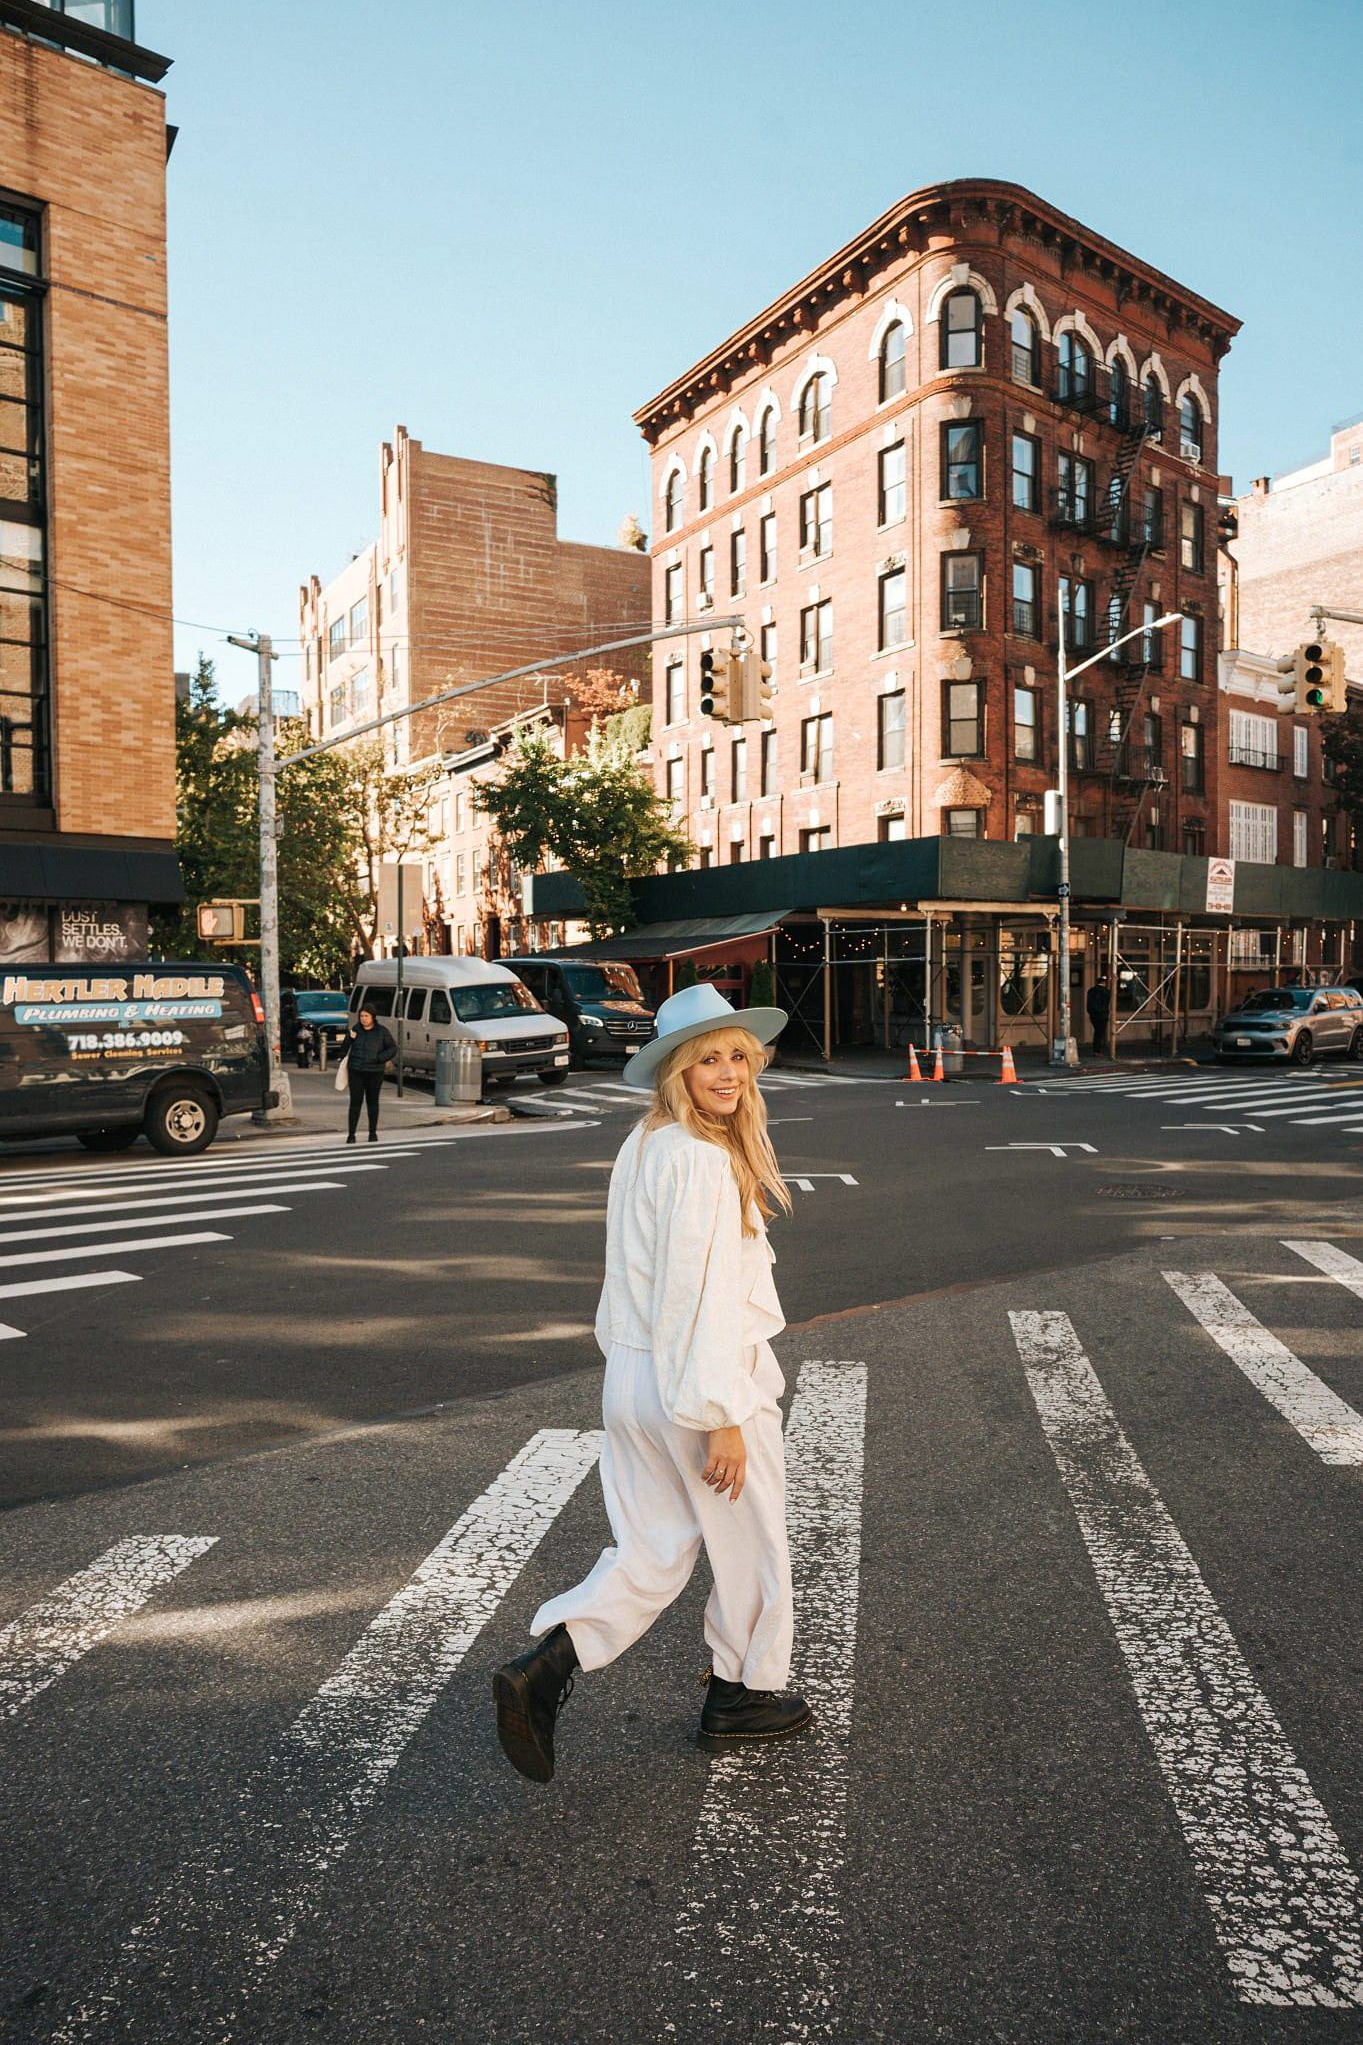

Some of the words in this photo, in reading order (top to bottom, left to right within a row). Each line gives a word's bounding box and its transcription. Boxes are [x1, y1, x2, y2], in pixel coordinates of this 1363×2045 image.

[62, 923, 122, 935] SETTLES.
[62, 936, 84, 947] WE
[86, 936, 128, 948] DON'T.
[3, 976, 128, 1005] HERTLER
[133, 974, 225, 1001] NADILE
[23, 1008, 119, 1021] PLUMBING
[124, 1004, 140, 1018] &
[144, 1004, 215, 1016] HEATING
[67, 1030, 183, 1050] 718.386.9009
[71, 1051, 101, 1060] Sewer
[104, 1049, 143, 1058] Cleaning
[147, 1047, 183, 1055] Services
